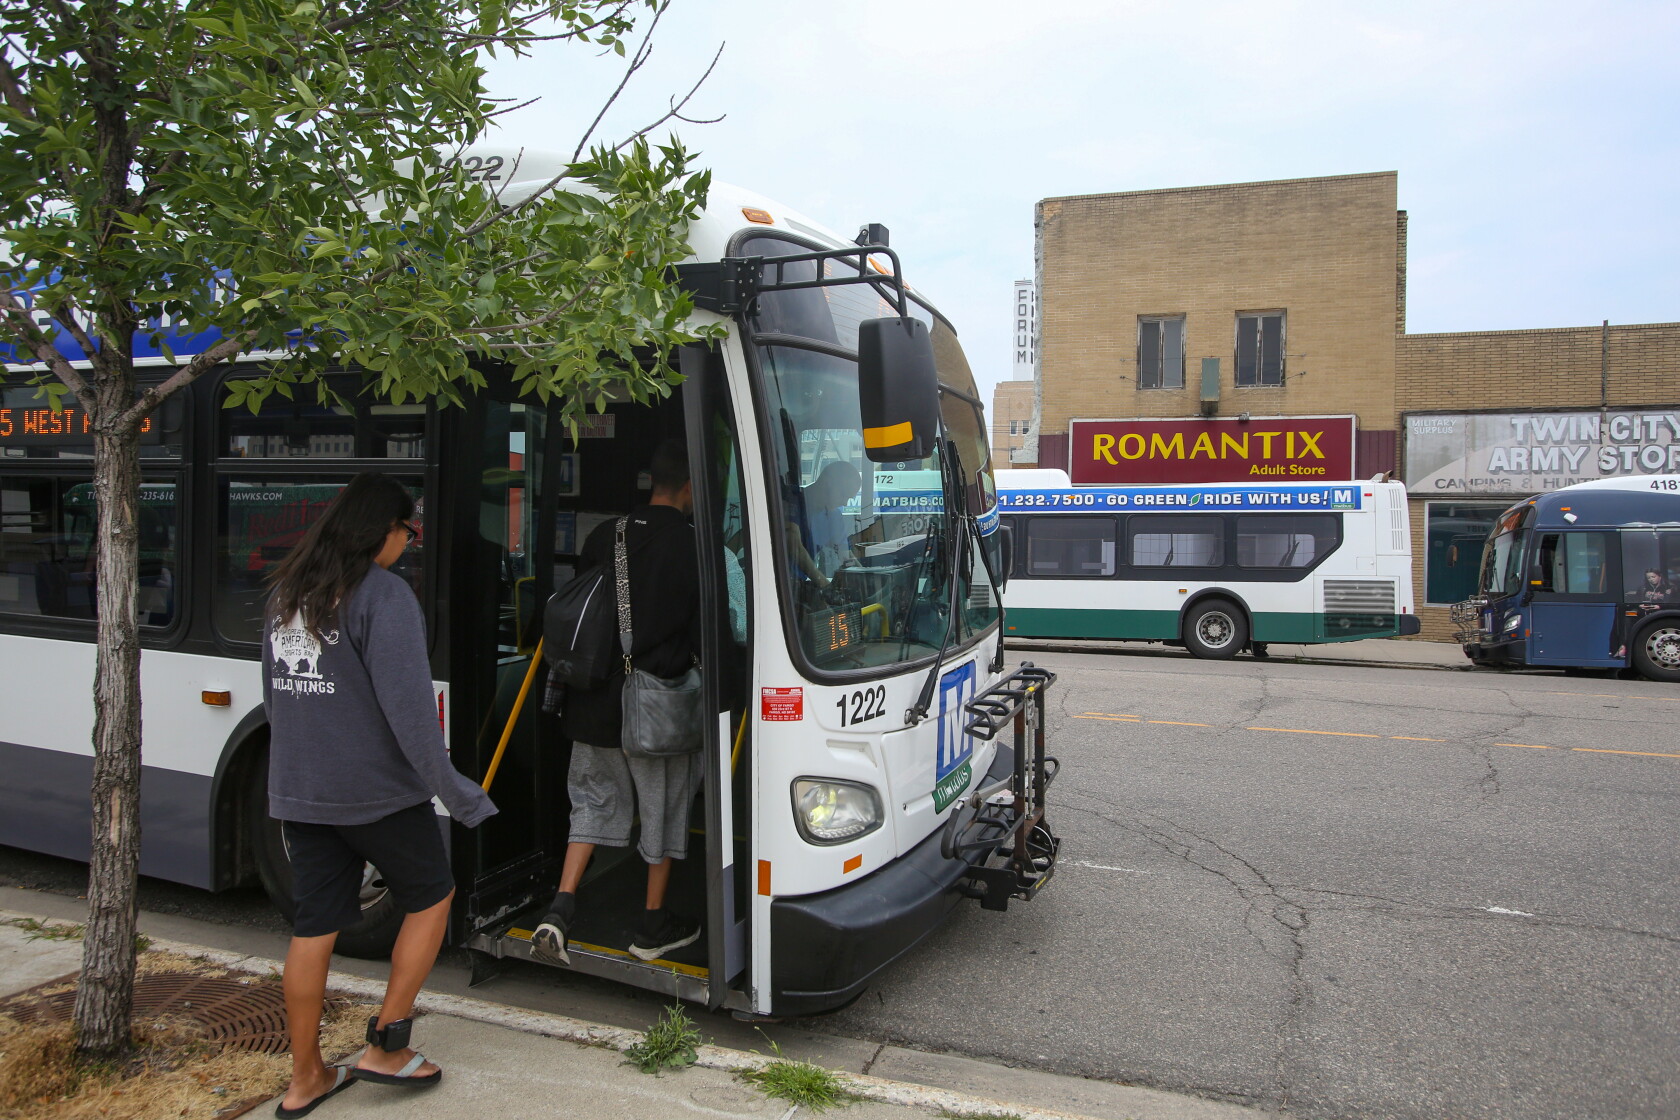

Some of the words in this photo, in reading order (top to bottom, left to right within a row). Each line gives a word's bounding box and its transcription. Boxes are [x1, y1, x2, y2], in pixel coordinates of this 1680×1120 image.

[1017, 289, 1028, 364] FORUM
[24, 410, 74, 434] WEST
[1411, 419, 1457, 428] MILITARY
[1413, 426, 1454, 435] SURPLUS
[1511, 416, 1600, 442] TWIN
[1093, 431, 1326, 466] ROMANTIX
[1488, 446, 1590, 472] ARMY
[1249, 464, 1286, 475] Adult
[1288, 464, 1326, 475] Store
[999, 494, 1094, 506] 1.232.7500
[1106, 494, 1128, 506] GO
[1133, 494, 1187, 506] GREEN
[1203, 493, 1242, 505] RIDE
[1247, 493, 1291, 505] WITH
[1297, 490, 1329, 505] US!
[1334, 489, 1352, 503] M
[828, 612, 849, 651] 15
[281, 635, 318, 652] AMERICAN
[284, 648, 302, 657] SPORTS
[272, 677, 293, 691] WILD
[294, 679, 335, 694] WINGS
[836, 684, 886, 728] 1222
[943, 677, 972, 769] M
